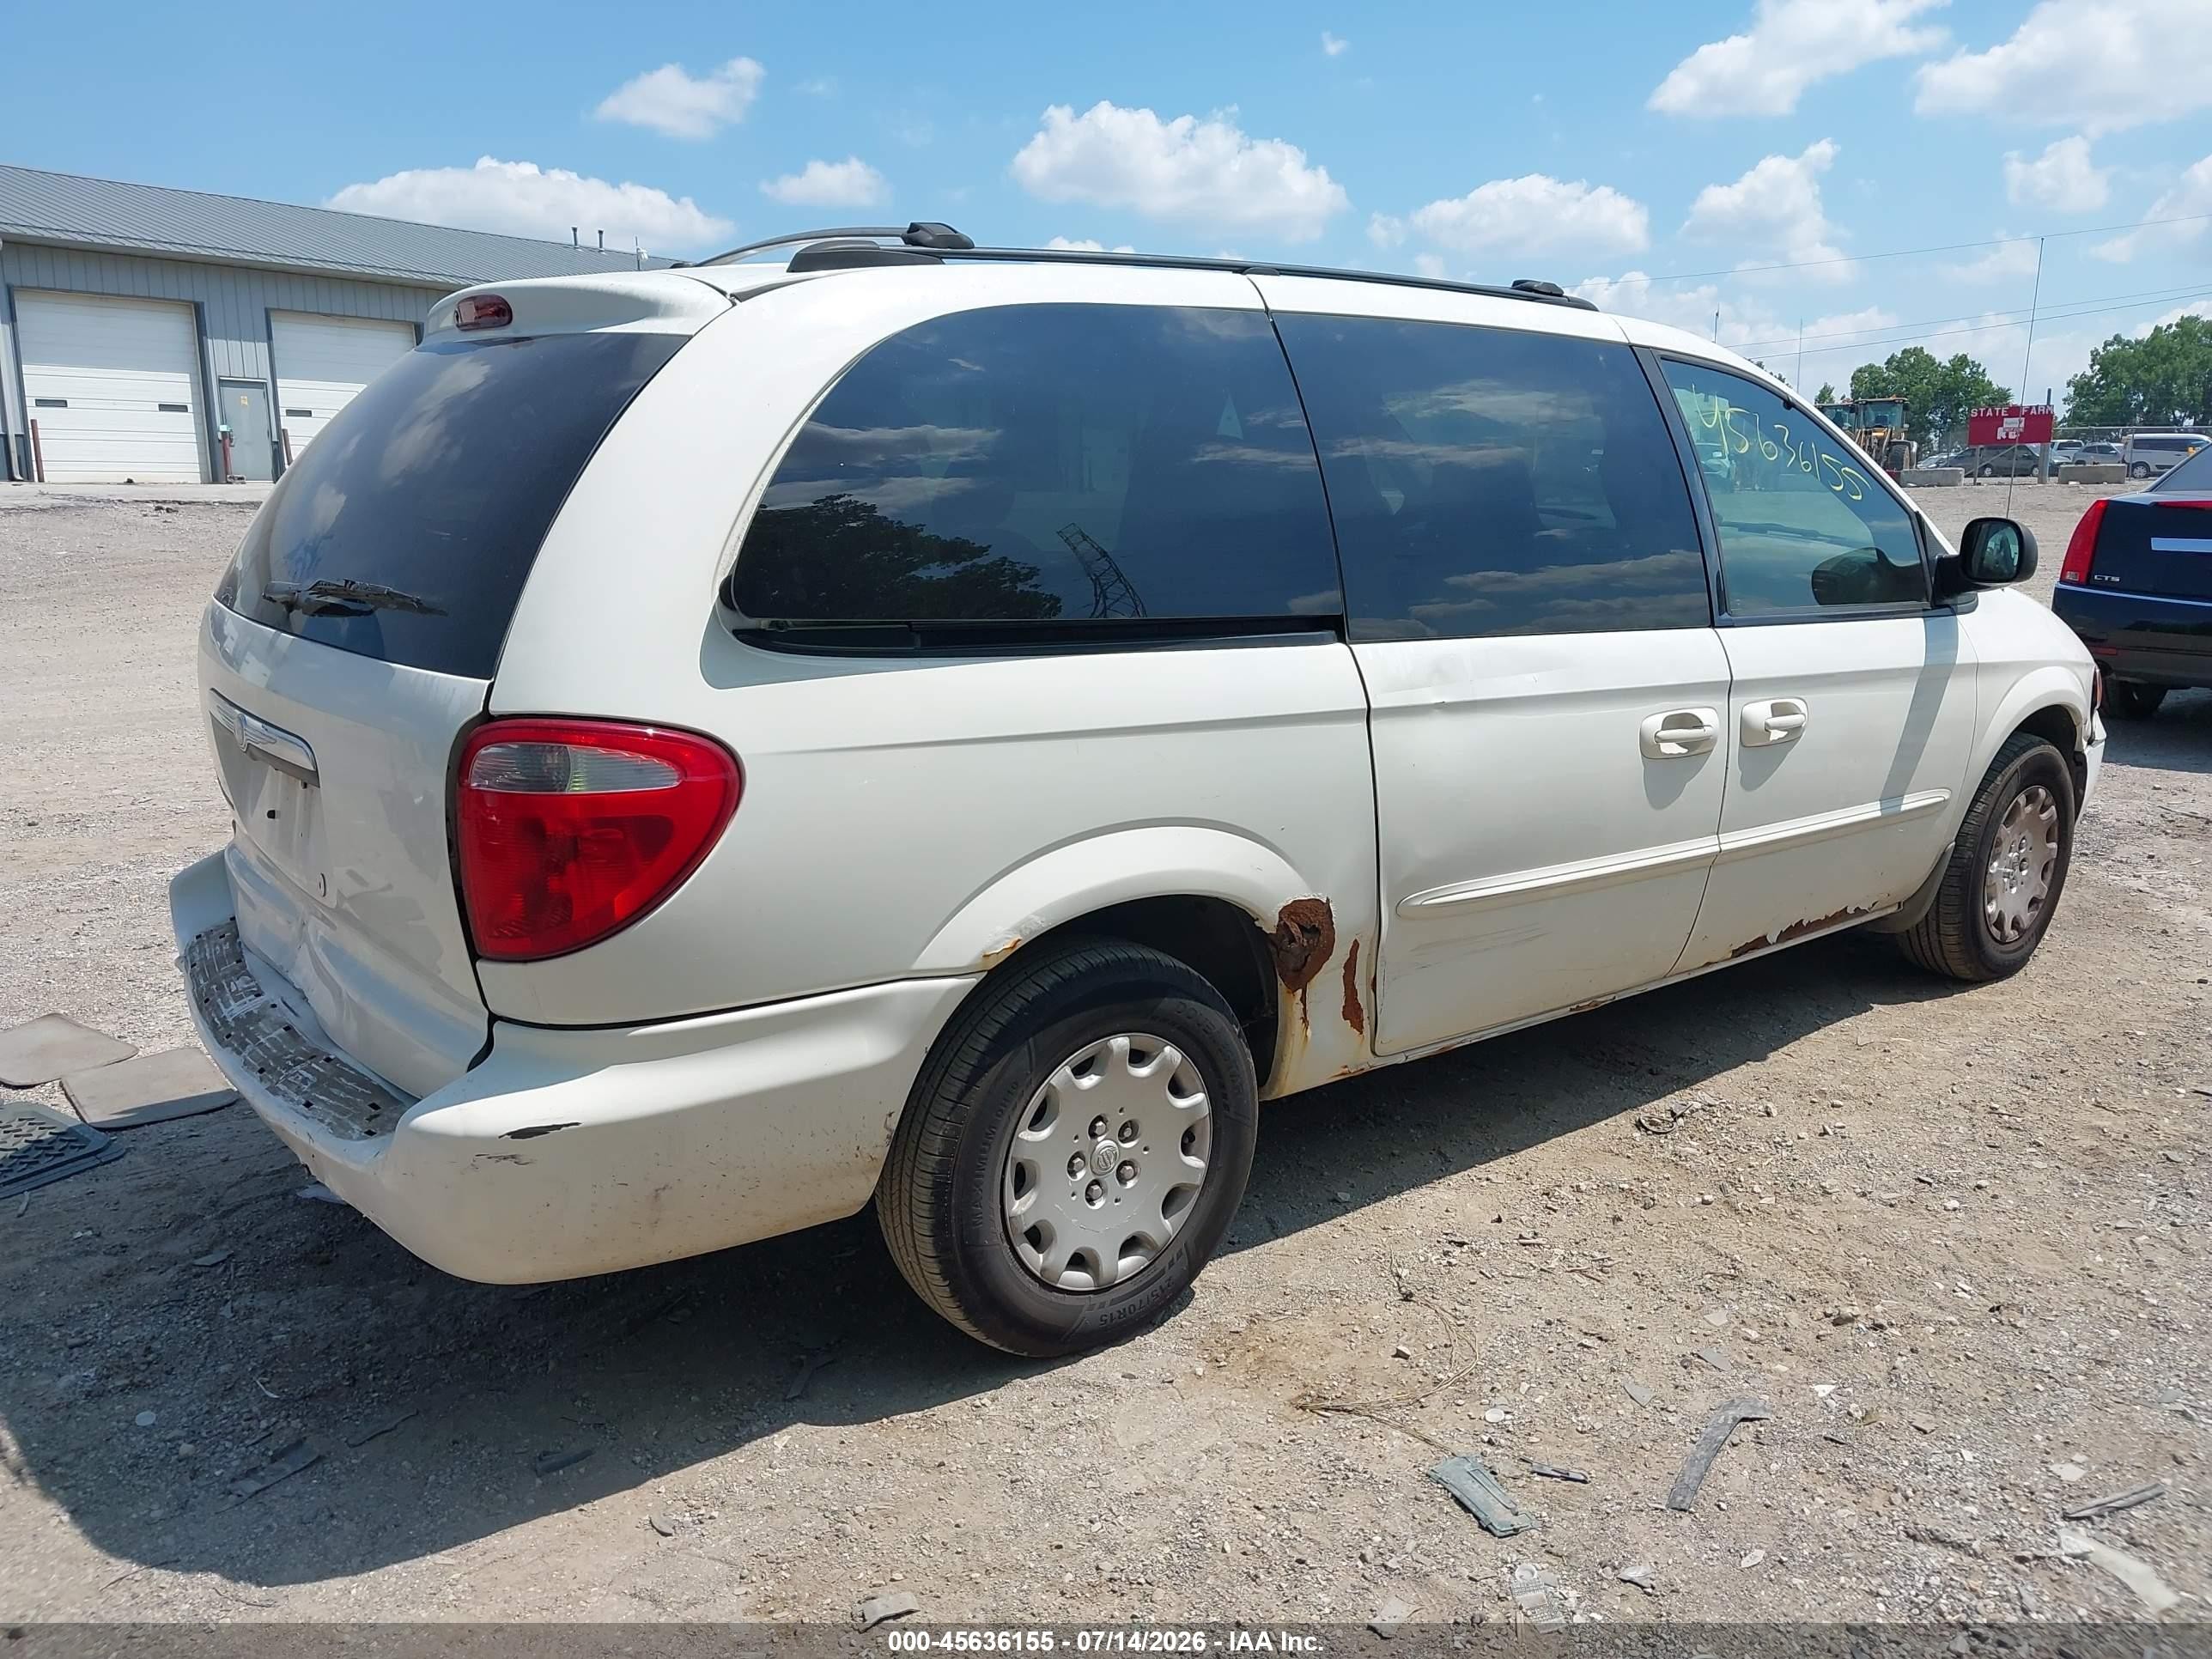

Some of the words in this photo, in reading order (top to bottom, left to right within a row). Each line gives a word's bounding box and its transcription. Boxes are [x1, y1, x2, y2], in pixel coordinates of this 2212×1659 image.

[1692, 383, 1873, 501] 45636155
[1971, 407, 2008, 417] STATE
[2022, 405, 2053, 415] FARM
